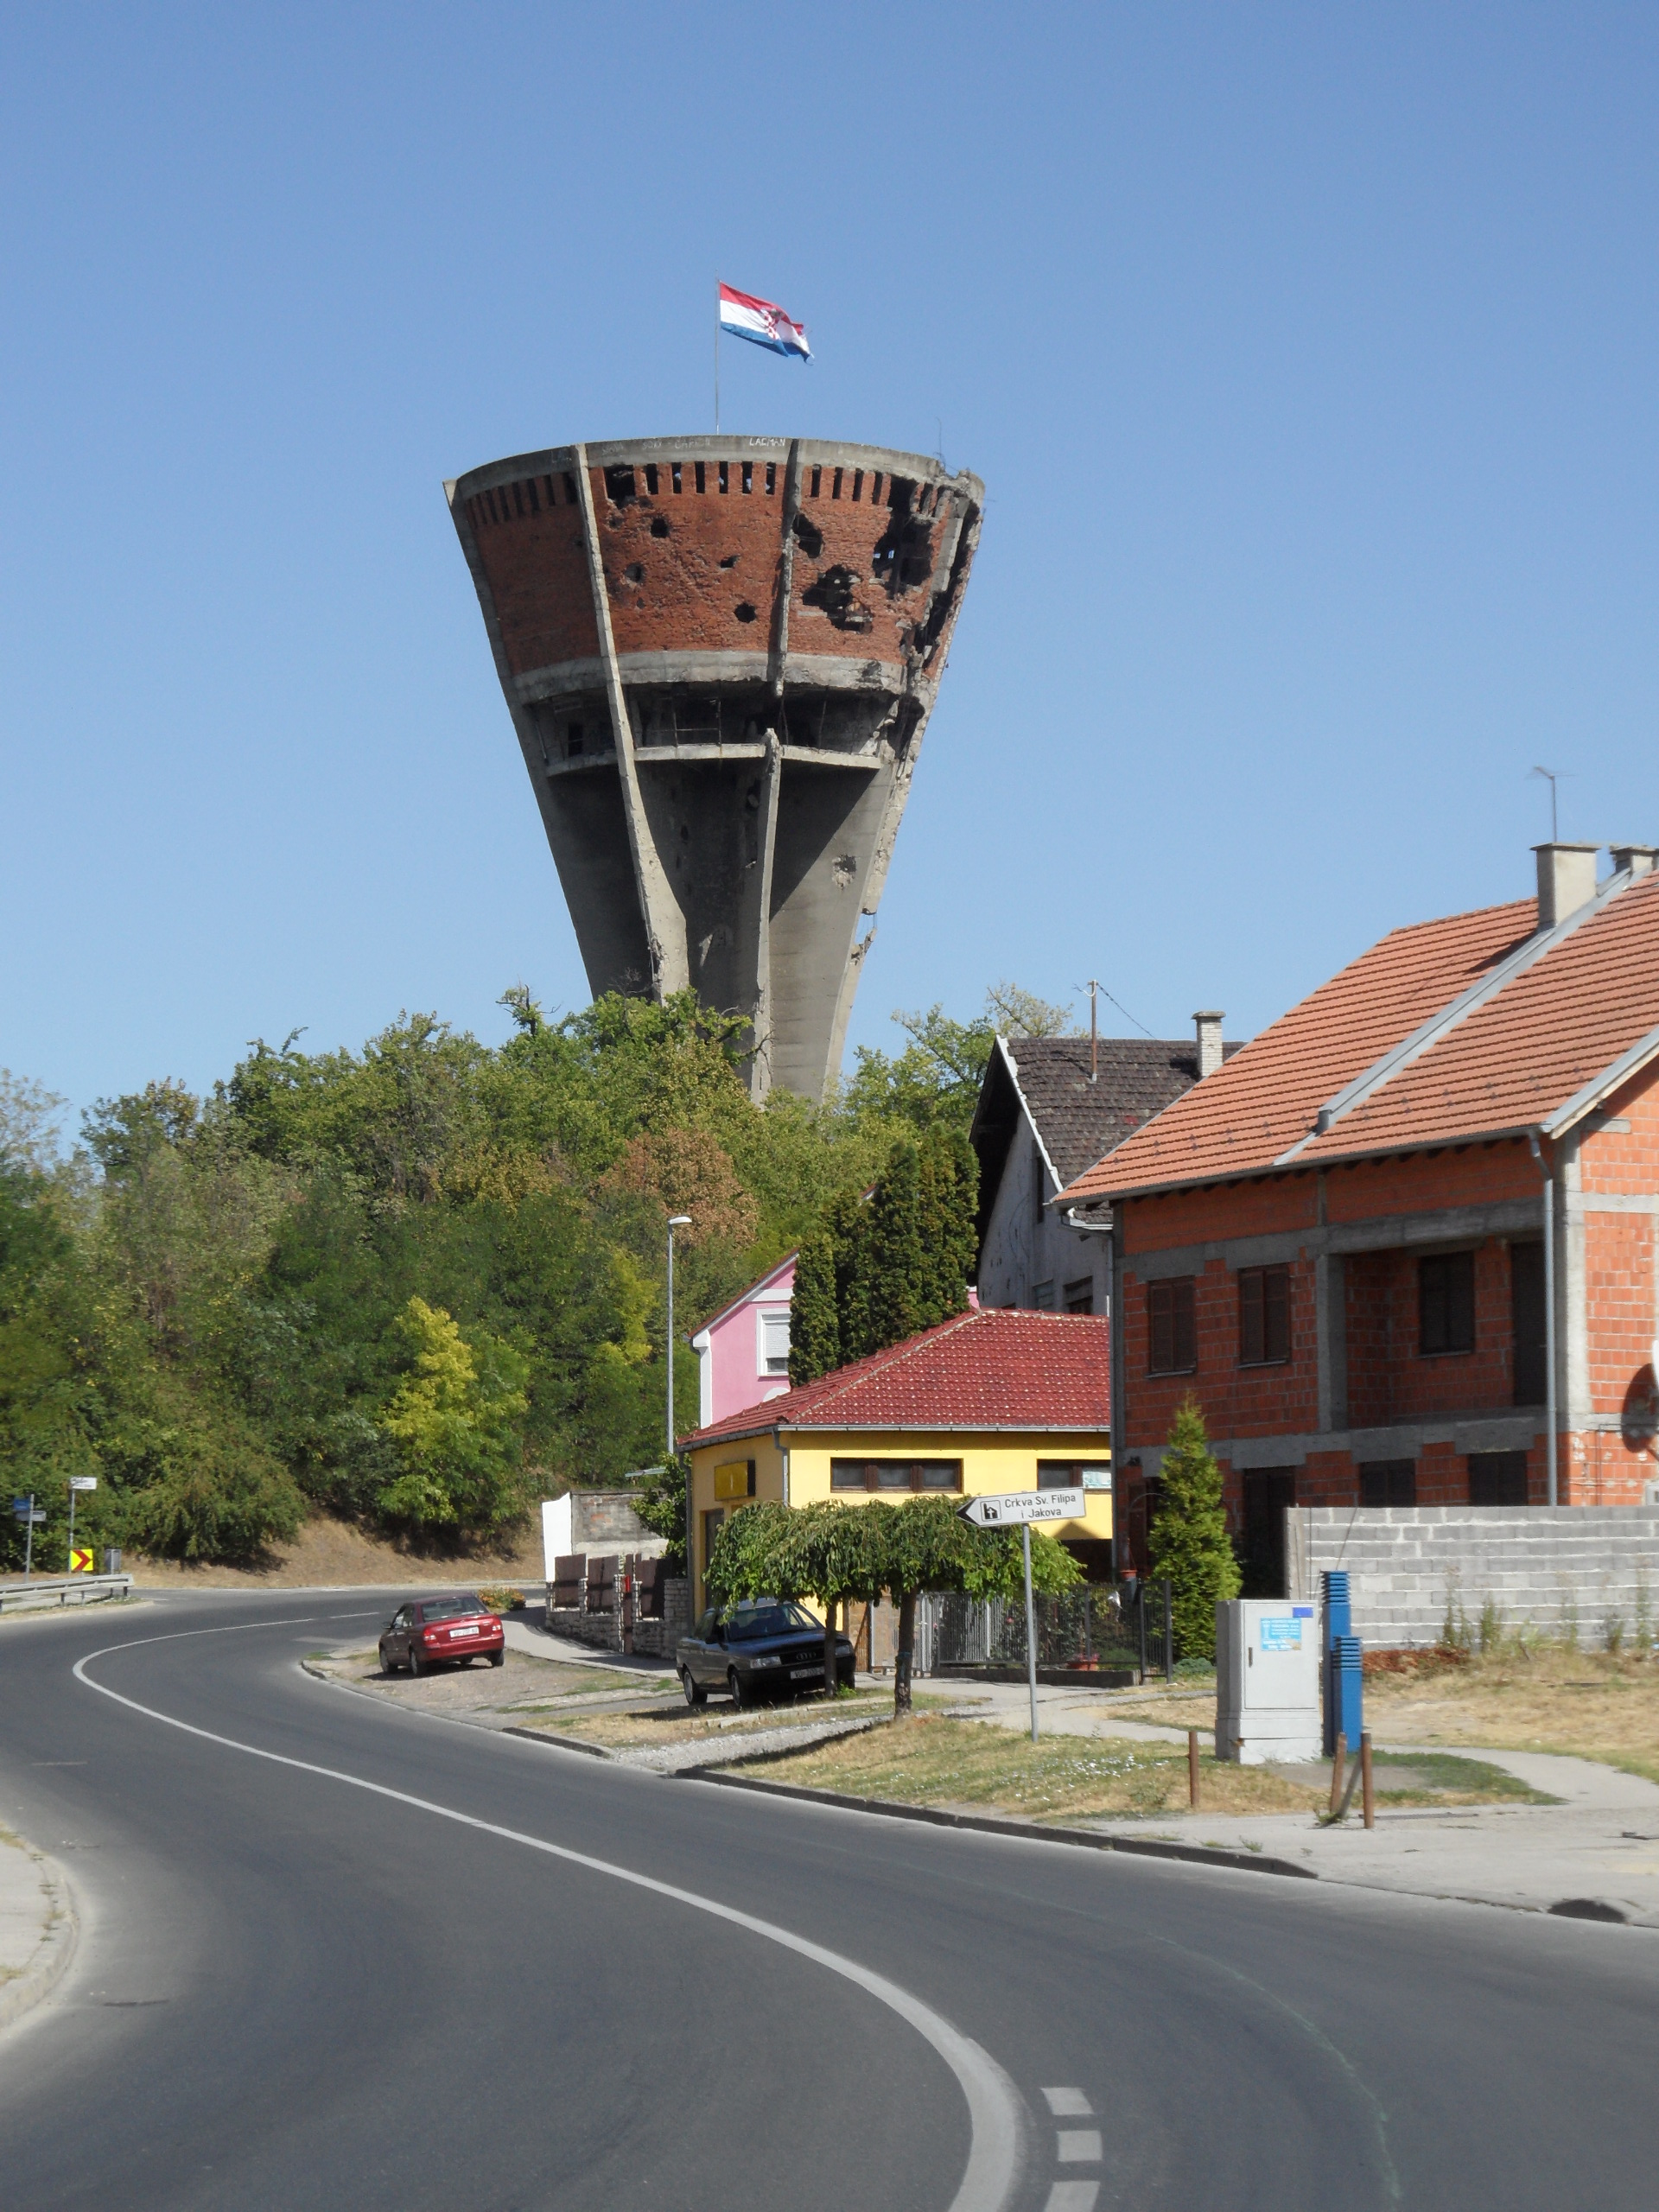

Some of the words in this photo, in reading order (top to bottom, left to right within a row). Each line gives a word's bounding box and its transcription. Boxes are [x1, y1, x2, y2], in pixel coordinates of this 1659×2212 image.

[1005, 1498, 1033, 1508] Crkva
[1035, 1496, 1049, 1505] Sv.
[1052, 1494, 1076, 1504] Filipa
[1028, 1509, 1062, 1518] Jakova
